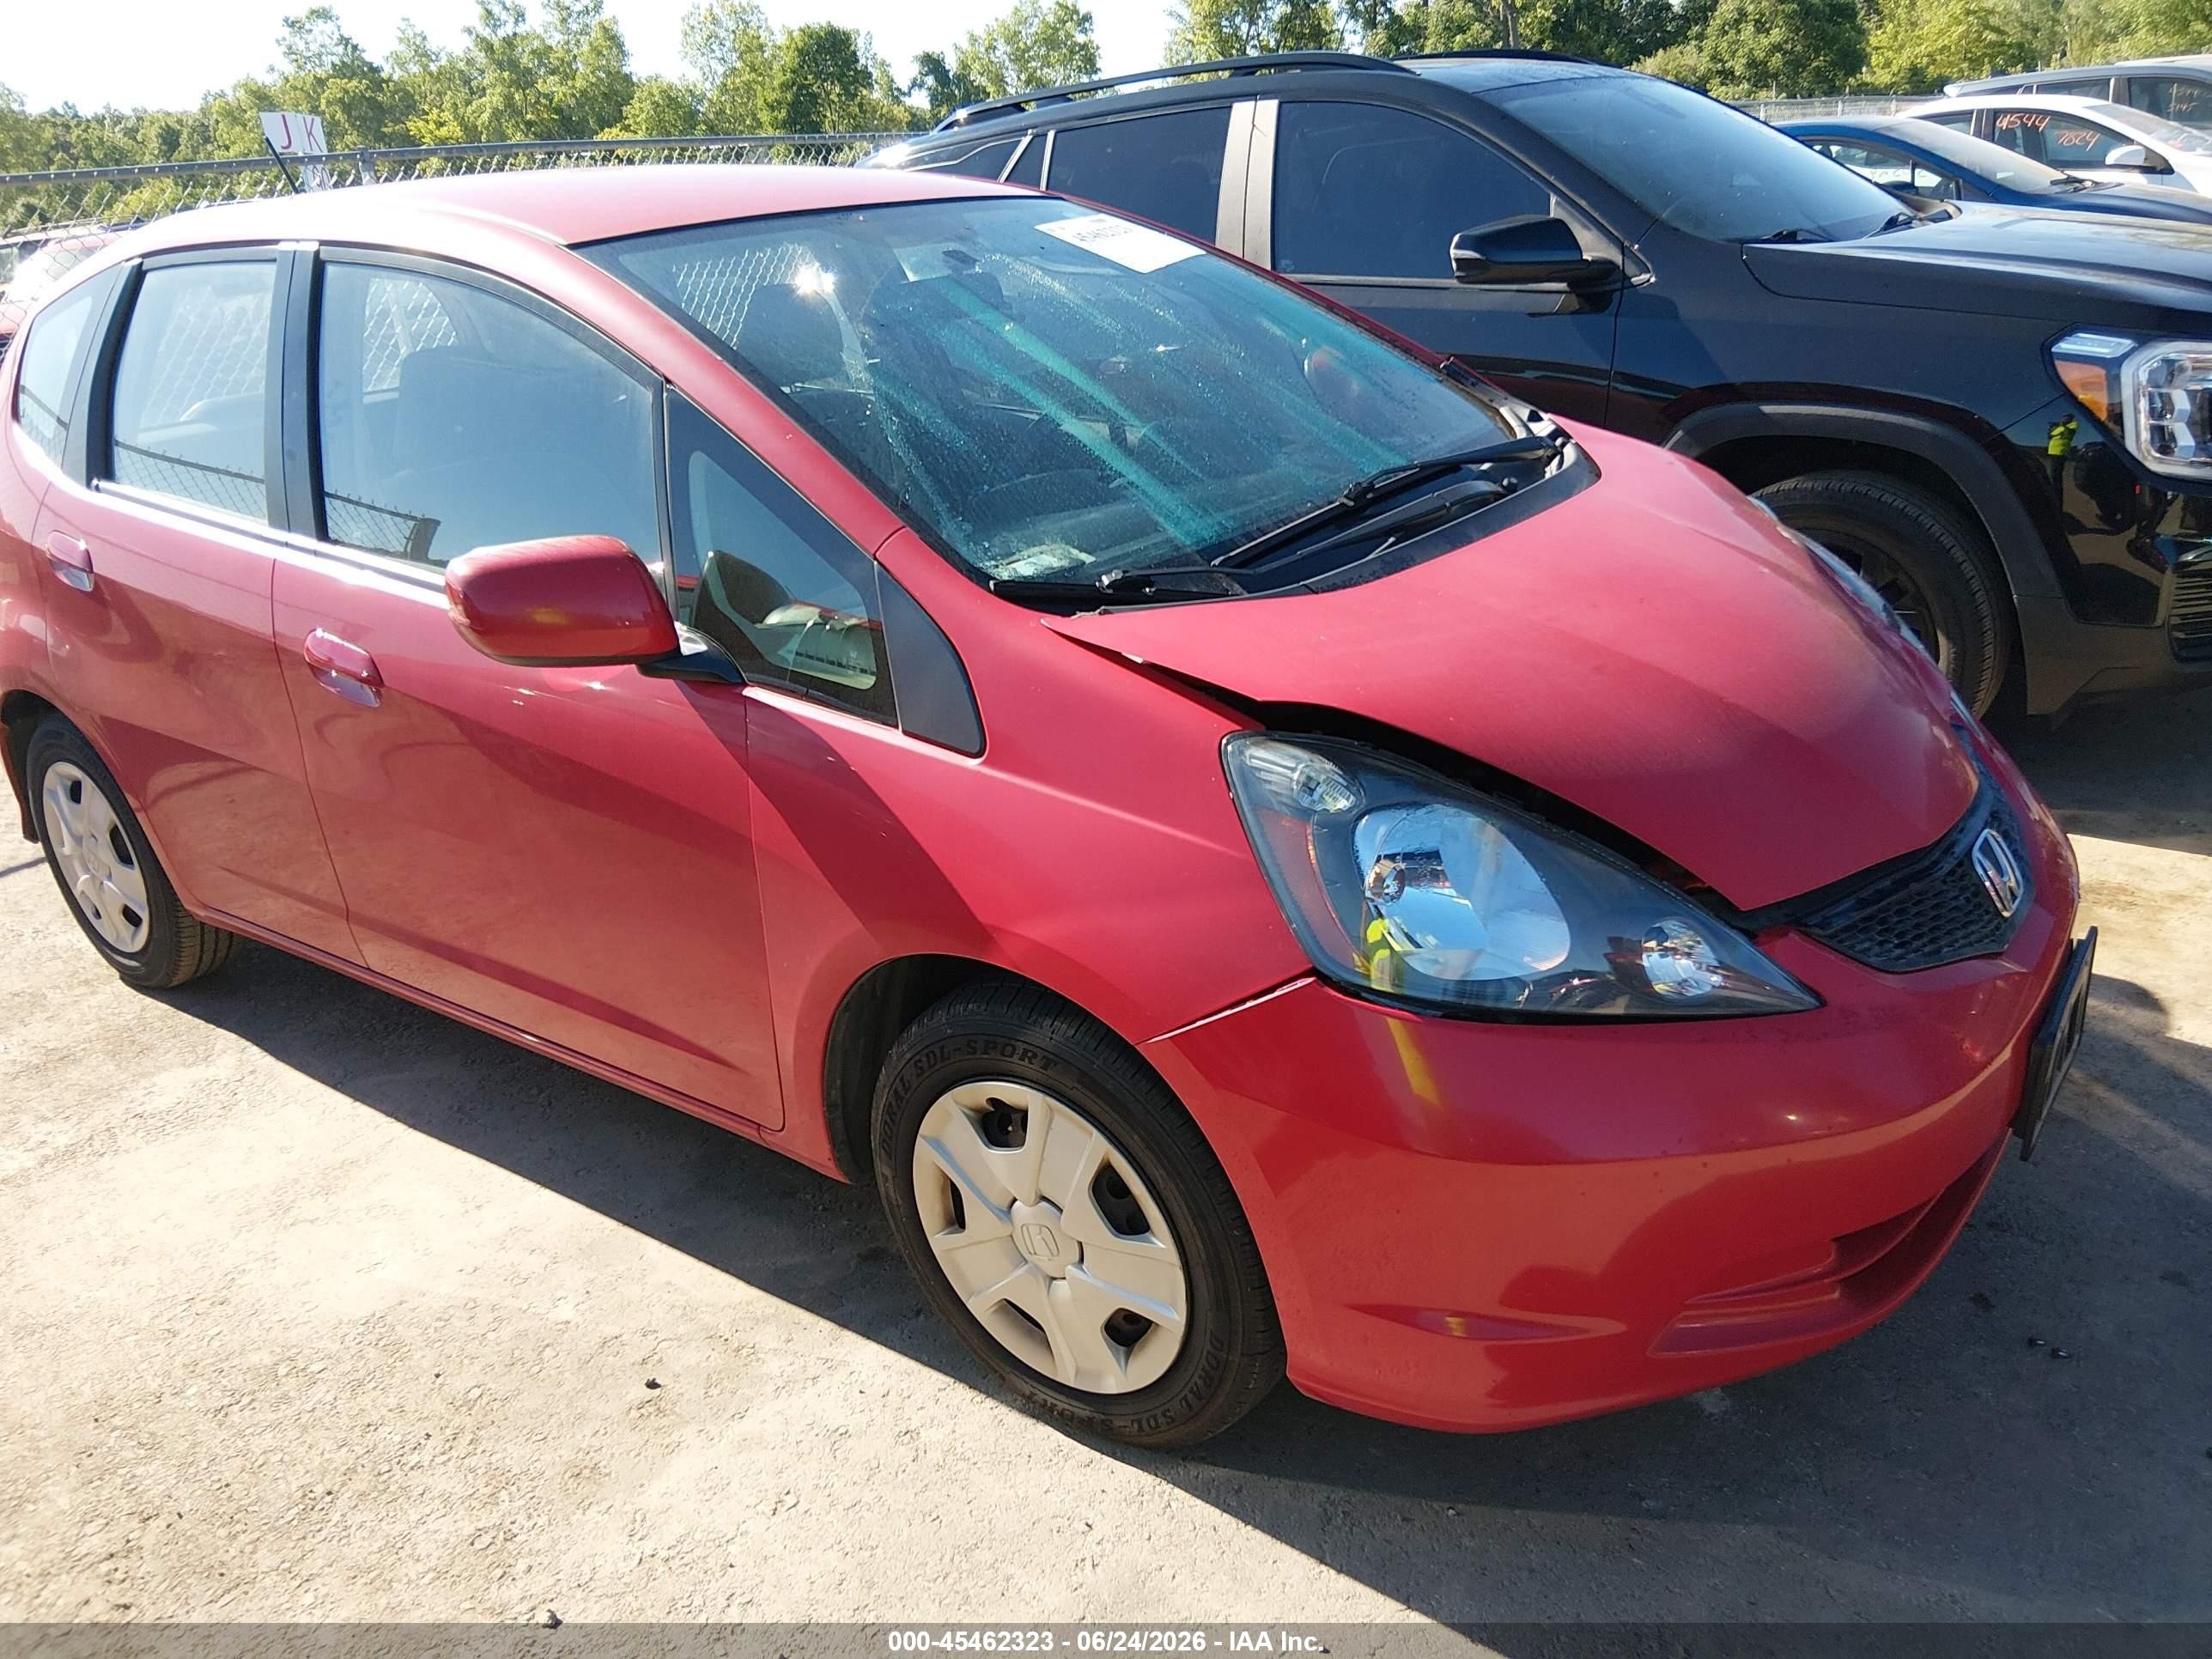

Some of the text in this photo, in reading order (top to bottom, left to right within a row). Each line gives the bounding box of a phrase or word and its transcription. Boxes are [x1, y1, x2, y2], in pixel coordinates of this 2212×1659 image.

[1996, 112, 2051, 133] 4544
[881, 1038, 1059, 1159] DORAL SDL-SPORT
